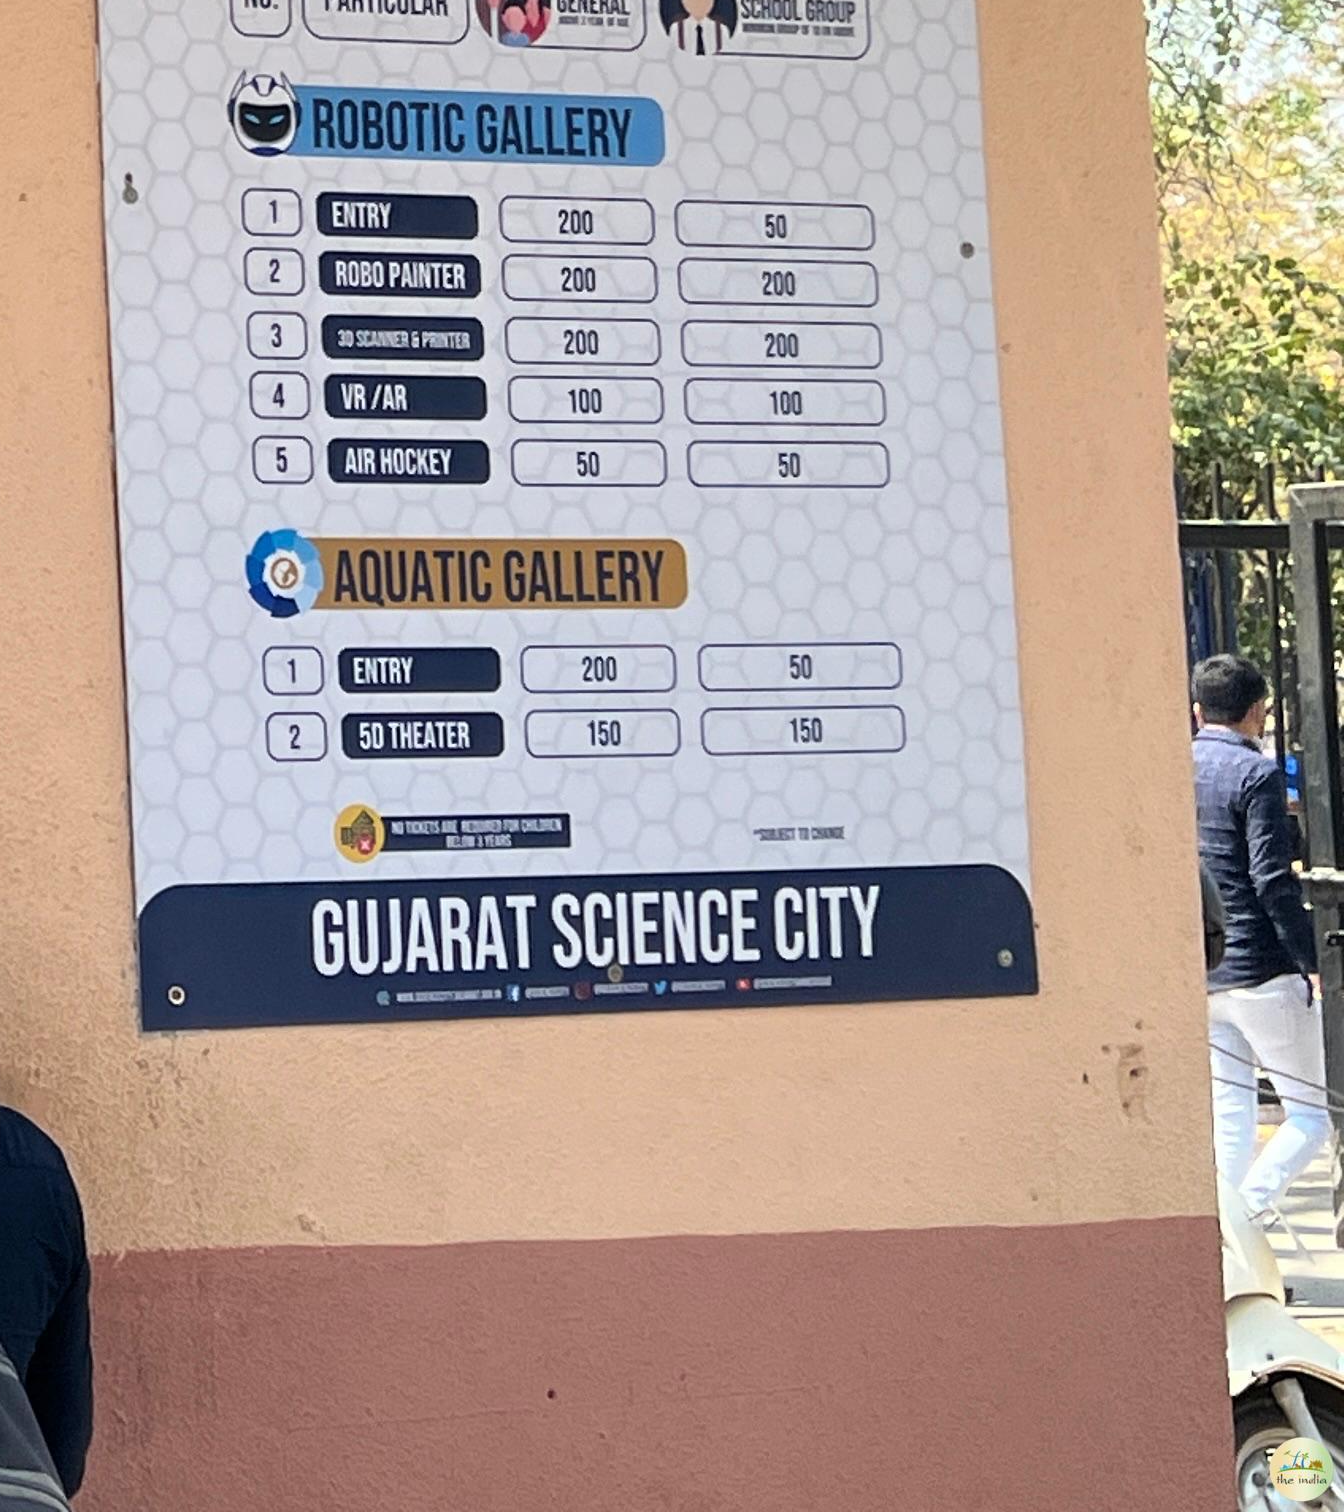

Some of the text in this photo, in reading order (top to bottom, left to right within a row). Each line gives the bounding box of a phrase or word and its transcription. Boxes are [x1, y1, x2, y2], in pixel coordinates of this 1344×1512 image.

[805, 0, 856, 23] GROUP
[313, 97, 631, 157] ROBOTIC GALLERY
[268, 200, 278, 224] 1
[332, 201, 392, 229] ENTRY
[558, 209, 593, 235] 200
[765, 214, 787, 239] 50
[269, 259, 281, 283] 2
[335, 260, 466, 290] ROBO PAINTER
[561, 267, 596, 293] 200
[762, 271, 796, 297] 200
[270, 323, 283, 348] 3
[338, 329, 354, 348] 3D
[356, 330, 409, 349] SCANNER
[422, 331, 471, 350] PRINTER
[563, 330, 599, 355] 200
[765, 333, 799, 358] 200
[272, 382, 285, 408] 4
[341, 383, 365, 410] VR
[568, 388, 602, 414] 100
[770, 391, 802, 416] 100
[276, 447, 288, 473] 5
[345, 448, 452, 475] AIR HOCKEY
[576, 452, 600, 477] 50
[778, 453, 801, 478] 50
[334, 548, 665, 607] AQUATIC GALLERY
[287, 659, 297, 684] 1
[353, 656, 413, 685] ENTRY
[582, 656, 617, 682] 200
[790, 655, 812, 680] 50
[289, 725, 301, 750] 2
[359, 722, 471, 749] 5D THEATER
[588, 720, 621, 747] 150
[790, 718, 823, 744] 150
[312, 886, 881, 978] GUJARAT SCIENCE CITY
